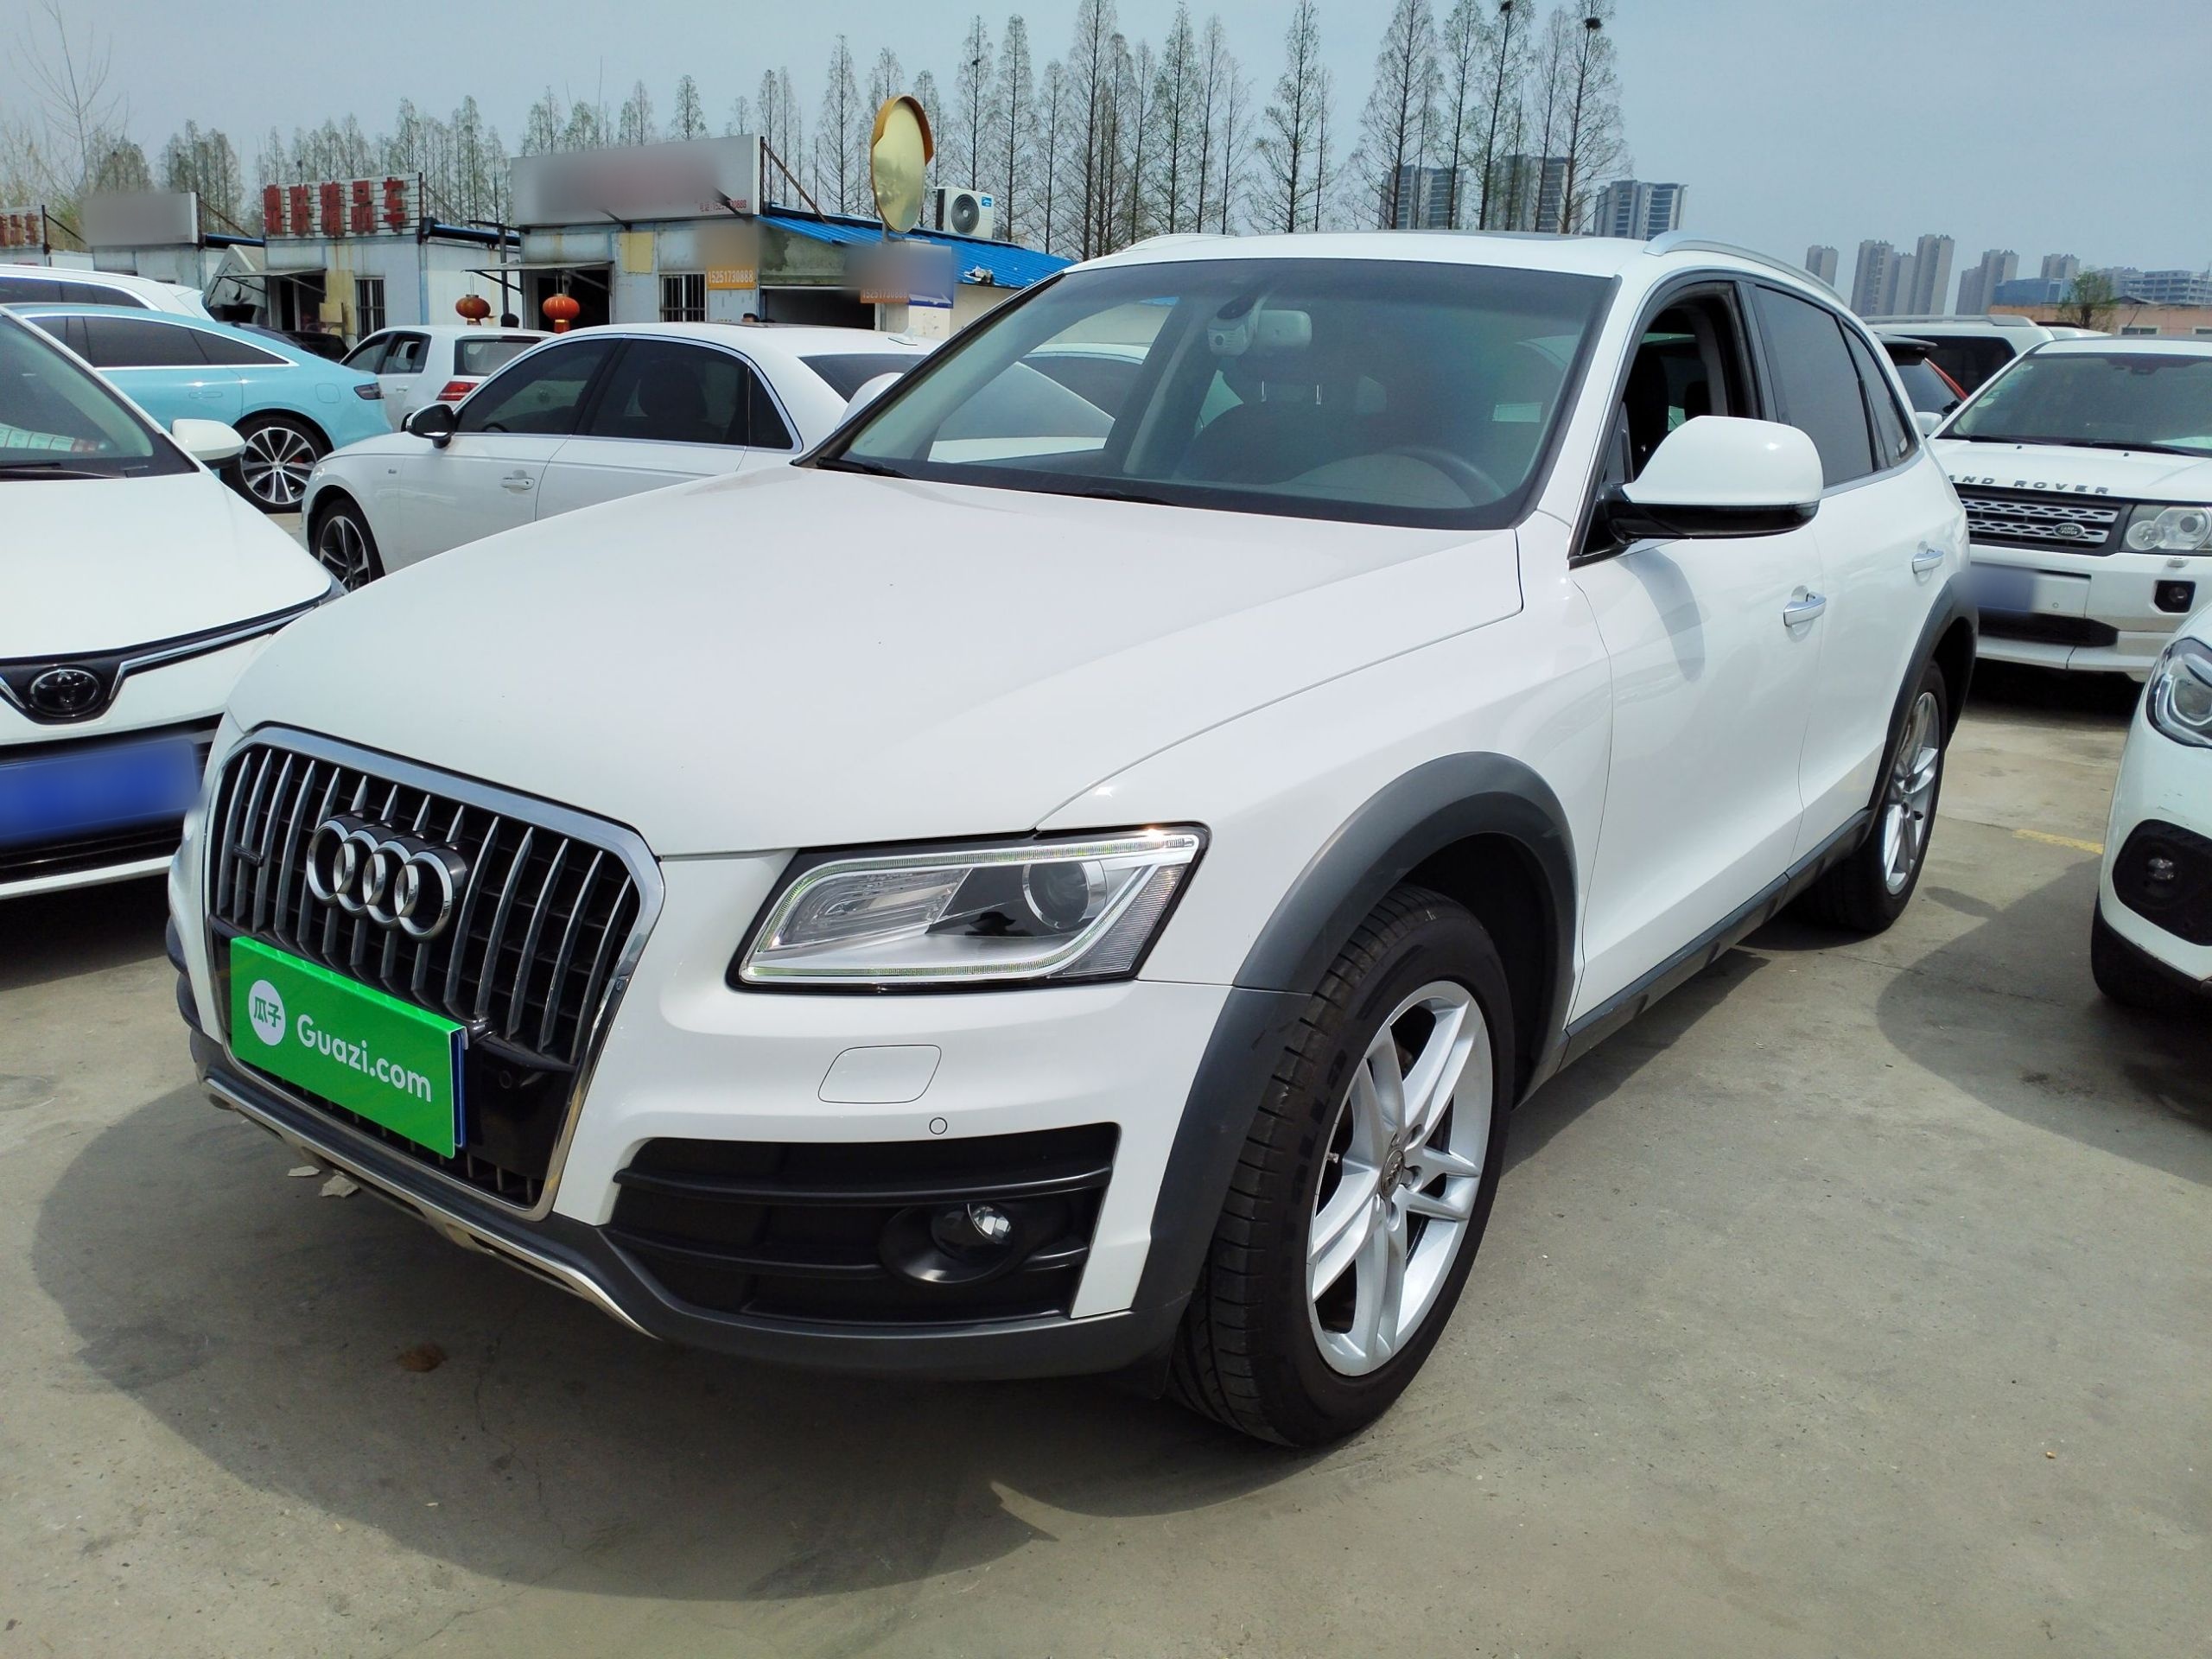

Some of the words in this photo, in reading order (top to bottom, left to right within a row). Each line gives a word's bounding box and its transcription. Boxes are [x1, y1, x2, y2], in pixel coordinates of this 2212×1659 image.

[708, 269, 753, 283] 15251730888
[2014, 480, 2110, 495] ROVER
[253, 996, 282, 1028] 瓜子
[296, 1014, 432, 1103] Guazi.com
